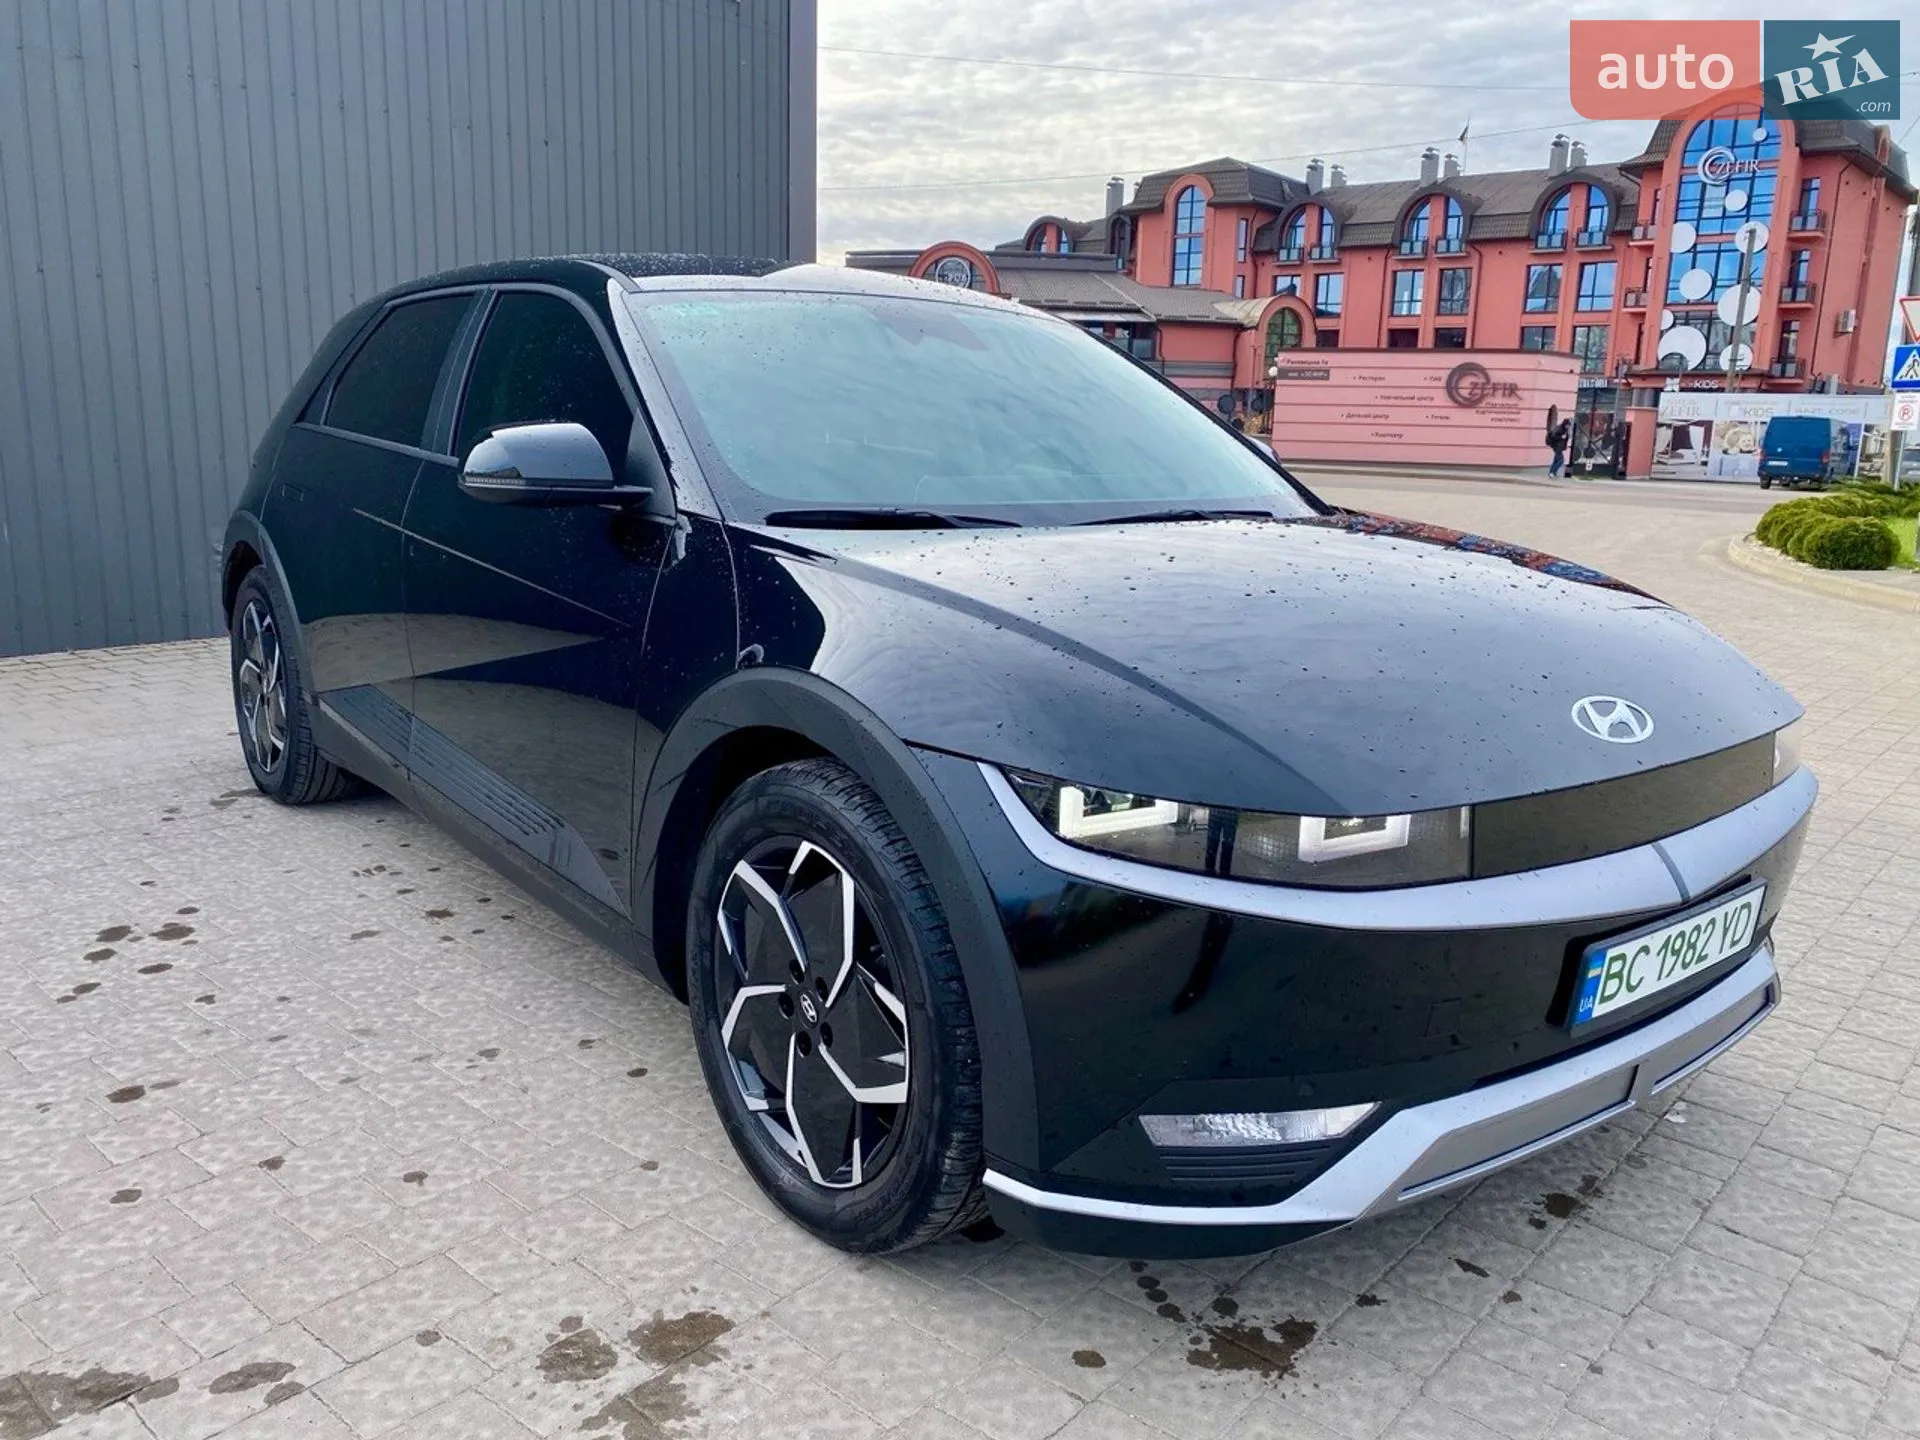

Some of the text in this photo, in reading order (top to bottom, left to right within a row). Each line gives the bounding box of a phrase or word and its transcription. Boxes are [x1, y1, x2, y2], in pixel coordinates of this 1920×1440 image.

[1468, 381, 1523, 400] ZEFIR
[1693, 379, 1719, 388] KIDS
[1743, 407, 1774, 418] KIDS
[1598, 901, 1752, 1005] BC 1982 YD
[1579, 996, 1594, 1013] UA
